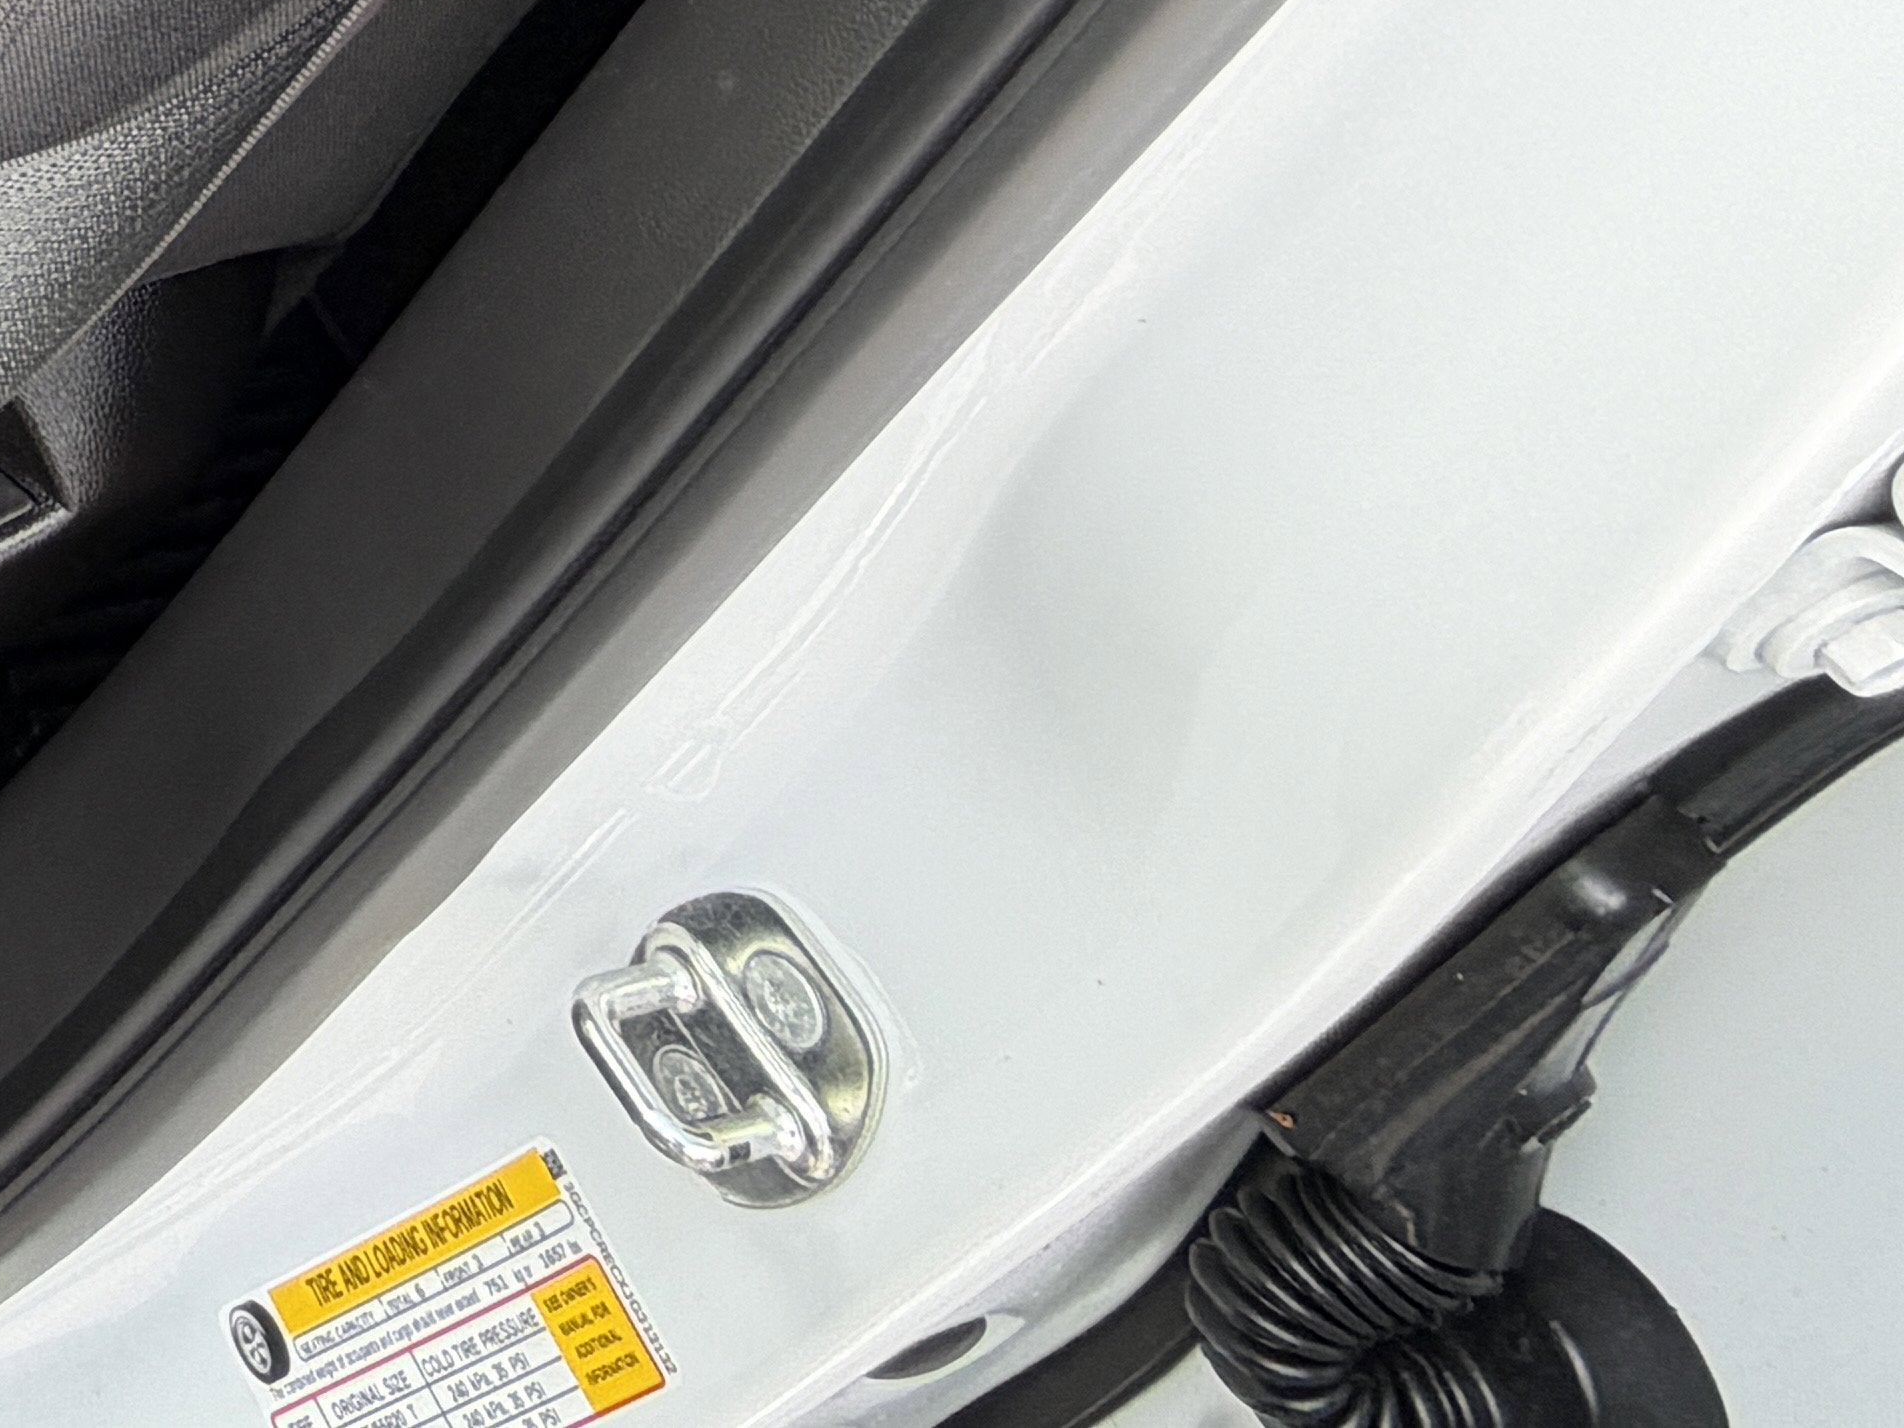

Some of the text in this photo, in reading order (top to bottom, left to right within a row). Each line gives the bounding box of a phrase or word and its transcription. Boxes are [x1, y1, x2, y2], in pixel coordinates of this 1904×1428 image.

[305, 1179, 514, 1306] TIRE AND LOADING INFORMATION
[420, 1307, 540, 1378] COLD TIRE PRESSURE
[508, 1351, 531, 1373] PSI
[331, 1383, 386, 1420] ORIGINAL
[382, 1370, 412, 1397] SIZE
[523, 1381, 547, 1403] PSI
